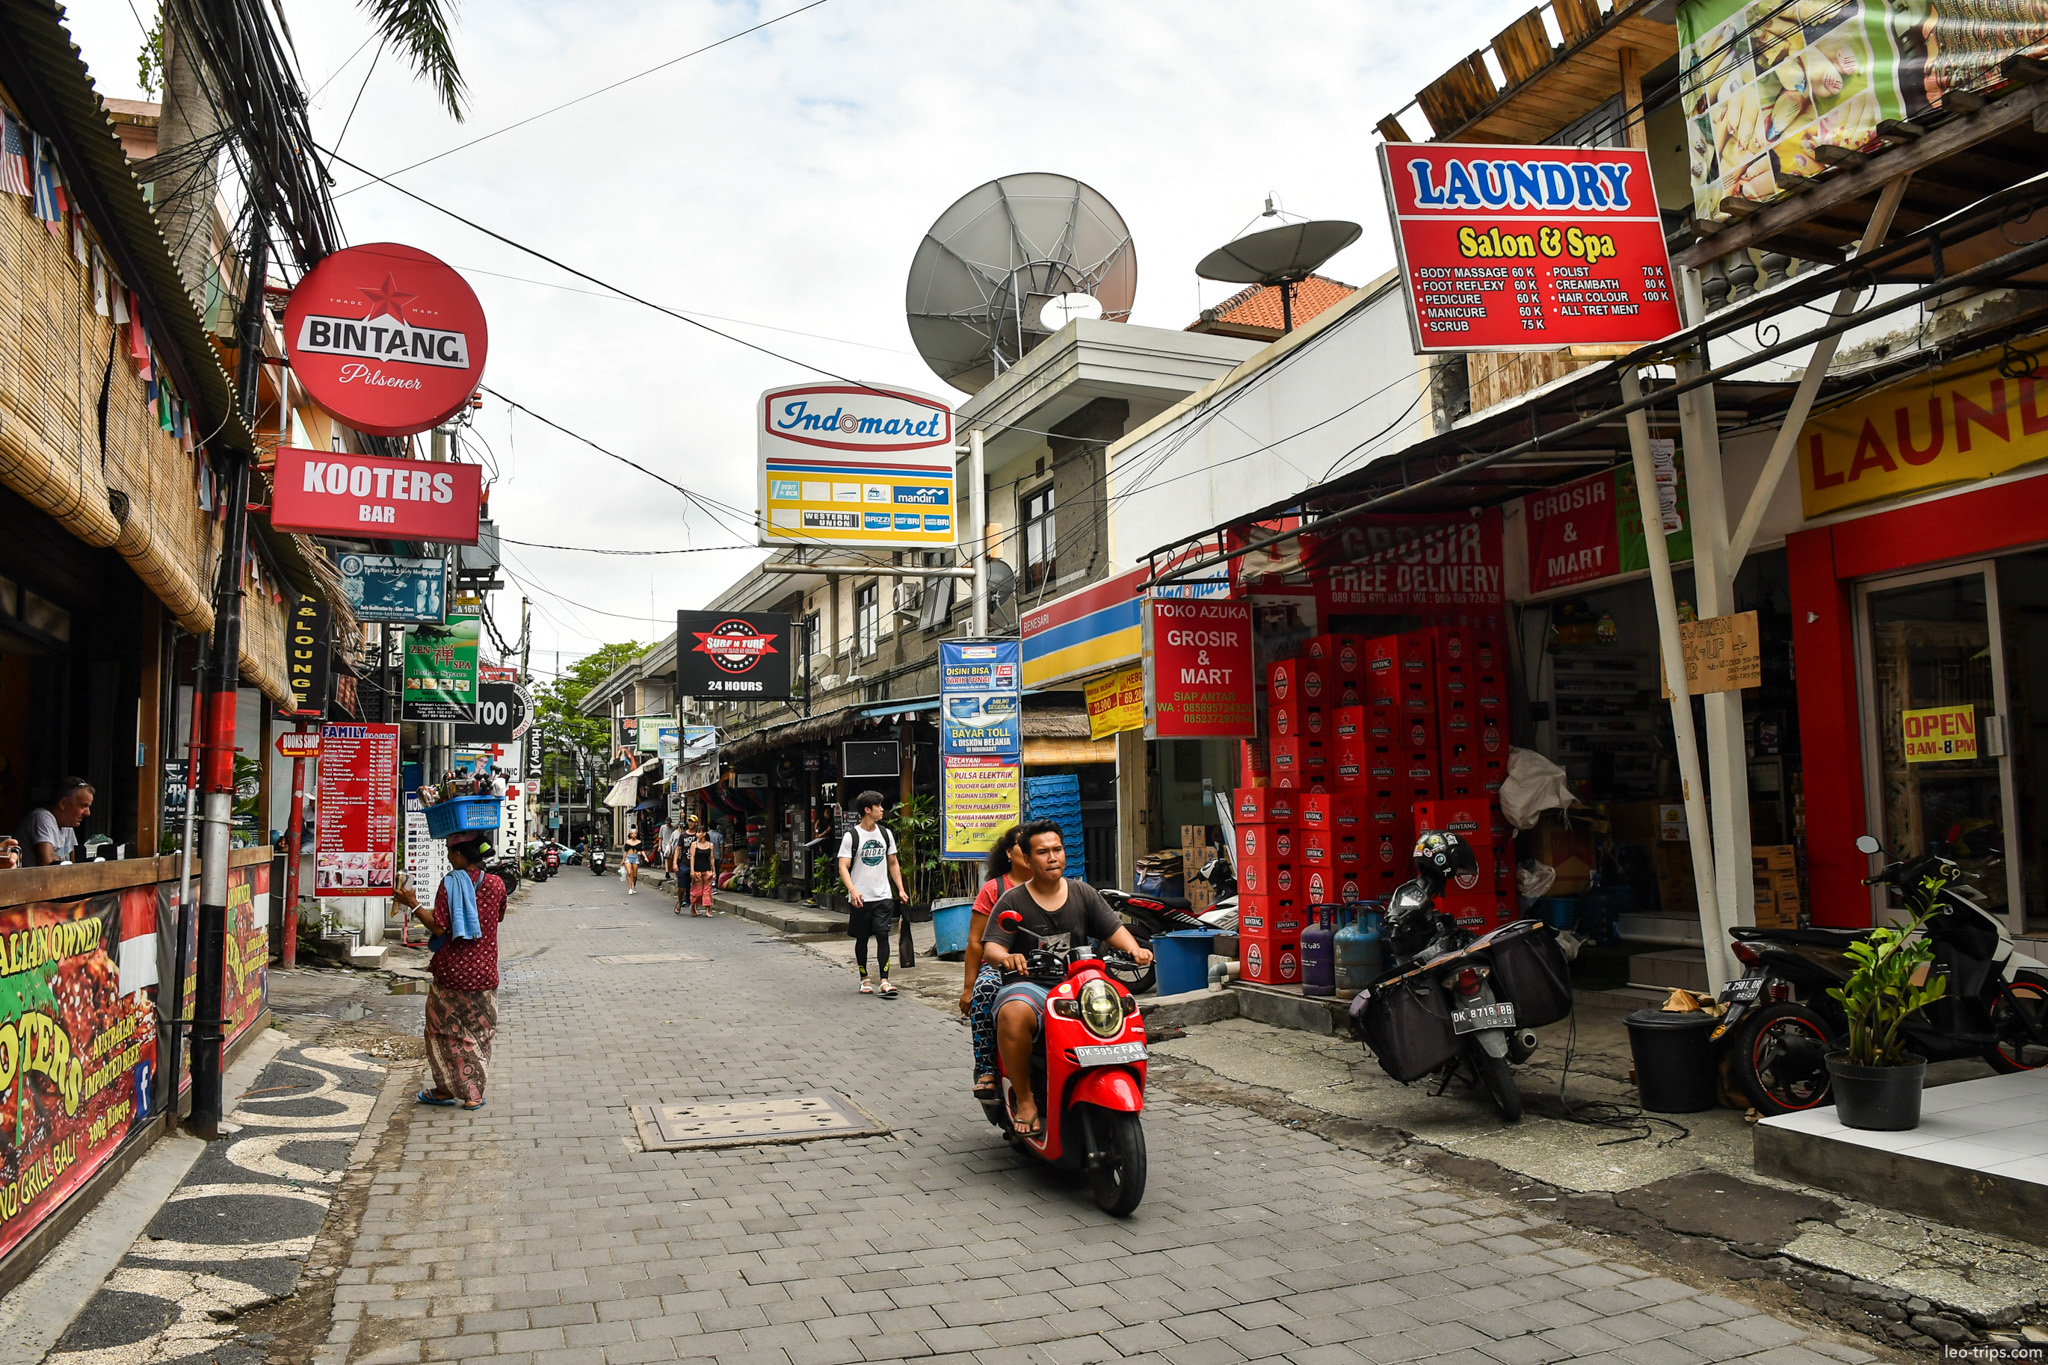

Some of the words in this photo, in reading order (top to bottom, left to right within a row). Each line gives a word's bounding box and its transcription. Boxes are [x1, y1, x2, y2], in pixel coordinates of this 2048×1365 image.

[1408, 159, 1632, 211] LAUNDRY
[1459, 226, 1536, 258] Salon
[1539, 226, 1561, 258] &
[1566, 227, 1616, 263] Spa
[1421, 267, 1452, 278] BODY
[1454, 267, 1508, 278] MASSAGE
[1512, 267, 1523, 278] 60
[1526, 267, 1534, 278] K
[1553, 267, 1590, 277] POLIST
[1642, 266, 1653, 276] 70
[1655, 266, 1663, 276] K
[1423, 280, 1453, 291] FOOT
[1456, 280, 1504, 291] REFLEXY
[1514, 280, 1526, 290] 60
[1528, 280, 1537, 290] K
[1556, 280, 1619, 290] CREAMBATH
[1645, 279, 1656, 289] 80
[1658, 279, 1666, 289] K
[1426, 294, 1481, 305] PEDICURE
[1517, 293, 1528, 304] 60
[1530, 293, 1540, 303] K
[1558, 292, 1583, 302] HAIR
[1586, 292, 1628, 302] COLOUR
[1642, 291, 1659, 301] 100
[1661, 291, 1669, 300] K
[330, 298, 362, 306] TRADE
[412, 308, 438, 316] MARK
[1428, 307, 1486, 318] MANICURE
[1519, 306, 1531, 316] 60
[1533, 306, 1542, 316] K
[1561, 305, 1580, 316] ALL
[1582, 305, 1609, 316] TRET
[1611, 304, 1639, 315] MENT
[1430, 320, 1469, 332] SCRUB
[1522, 320, 1533, 330] 75
[1536, 320, 1546, 330] K
[308, 320, 460, 363] BINTANG
[339, 363, 422, 390] Pilsener
[777, 401, 940, 437] Indomaret
[303, 461, 454, 504] KOOTERS
[898, 493, 935, 503] mandiri
[1533, 481, 1606, 521] GROSIR
[360, 505, 395, 524] BAR
[1563, 522, 1578, 543] &
[1341, 524, 1482, 565] GROSIR
[1548, 545, 1605, 578] MART
[1329, 566, 1388, 592] FREE
[1397, 564, 1500, 594] DELIVERY
[1155, 604, 1196, 617] TOKO
[1200, 606, 1248, 619] AZUKA
[1023, 613, 1049, 632] BENESARI
[706, 637, 733, 649] SURF
[742, 638, 765, 649] TURF
[1167, 630, 1238, 647] GROSIR
[290, 621, 314, 703] LOUNGE
[410, 646, 431, 654] ZEN
[452, 661, 472, 670] SPA
[1197, 650, 1210, 665] &
[1371, 660, 1391, 669] BINTANG
[946, 668, 969, 676] DISINI
[971, 667, 989, 675] BISA
[1181, 668, 1232, 684] MART
[708, 681, 722, 691] 24
[725, 681, 763, 691] HOURS
[1174, 692, 1198, 701] SIAP
[1201, 692, 1236, 701] ANTAR
[1157, 703, 1174, 712] WA
[322, 726, 367, 738] FAMILY
[1905, 712, 1974, 738] OPEN
[952, 729, 984, 738] BAYAR
[987, 728, 1010, 737] TOLL
[304, 735, 319, 749] SHOP
[531, 728, 542, 764] Hurley
[979, 771, 1013, 779] ELEKTRIK
[1340, 766, 1358, 774] BINTANG
[1305, 812, 1322, 820] BINTANG
[506, 804, 518, 855] CLINIC
[1448, 823, 1478, 831] BINTANG
[1244, 918, 1262, 926] BINTANG
[1276, 921, 1298, 929] BINTANG
[1456, 917, 1484, 925] BINTANG
[52, 916, 102, 961] OWNED
[1454, 1011, 1466, 1022] DK
[1470, 1006, 1495, 1018] 8718
[92, 1014, 136, 1061] AUSTRALIAN
[1078, 1049, 1092, 1057] DK
[84, 1051, 122, 1100] IMPORTED
[122, 1042, 140, 1073] BEEF
[88, 1119, 107, 1149] 300g
[107, 1099, 130, 1130] Ribeye
[21, 1154, 54, 1204] GRILL
[53, 1131, 76, 1176] BALI
